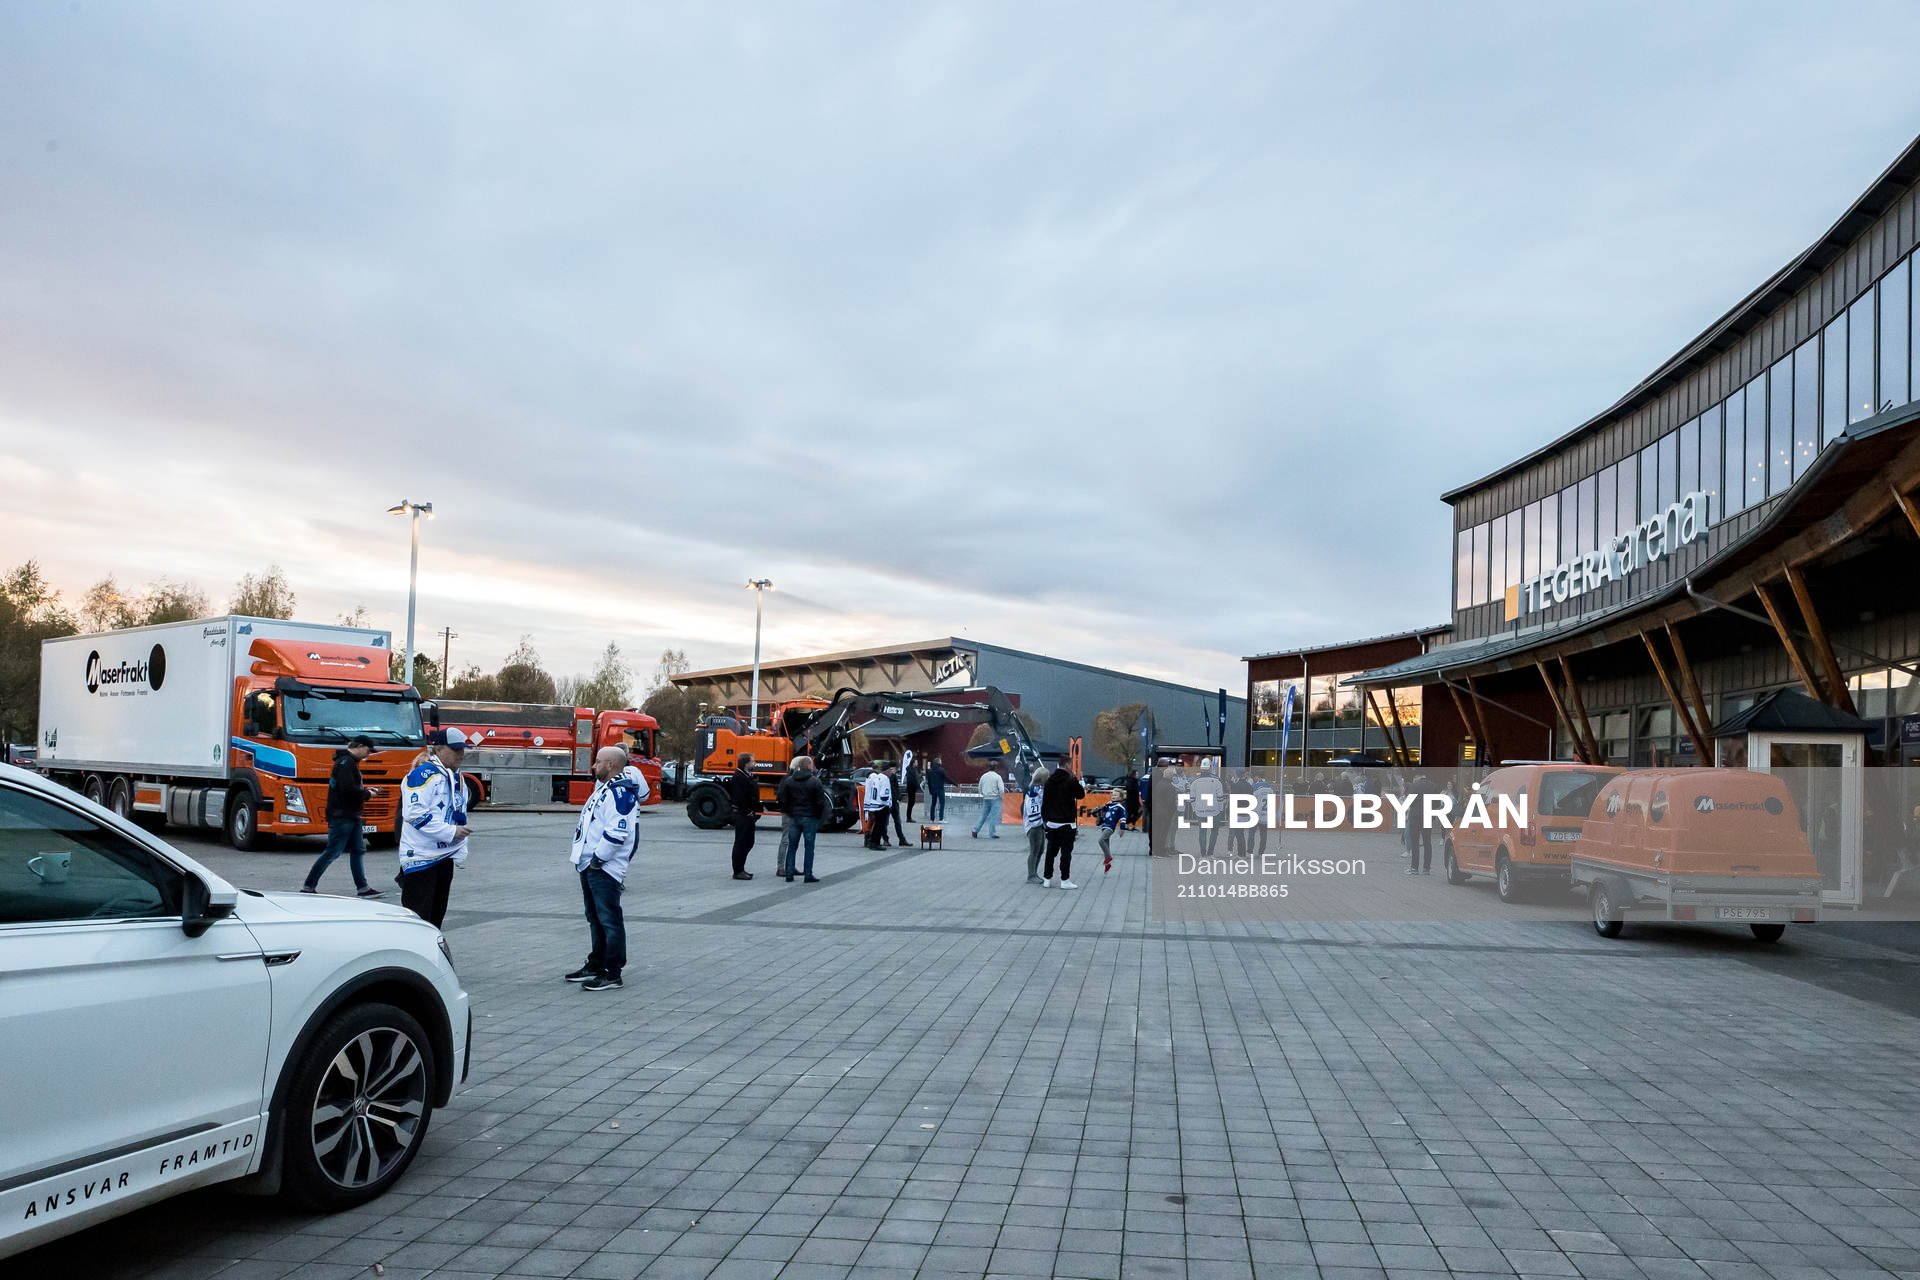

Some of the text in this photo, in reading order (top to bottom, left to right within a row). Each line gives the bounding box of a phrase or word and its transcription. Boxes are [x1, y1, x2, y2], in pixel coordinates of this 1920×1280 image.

[1620, 491, 1707, 576] arena
[87, 658, 147, 686] MaserFrakt
[913, 708, 960, 719] VOLVO
[1030, 804, 1040, 814] 27
[1553, 831, 1568, 841] ZDE
[1723, 908, 1765, 918] PSE 795
[24, 1134, 253, 1219] ANSVAR FRAMTID
